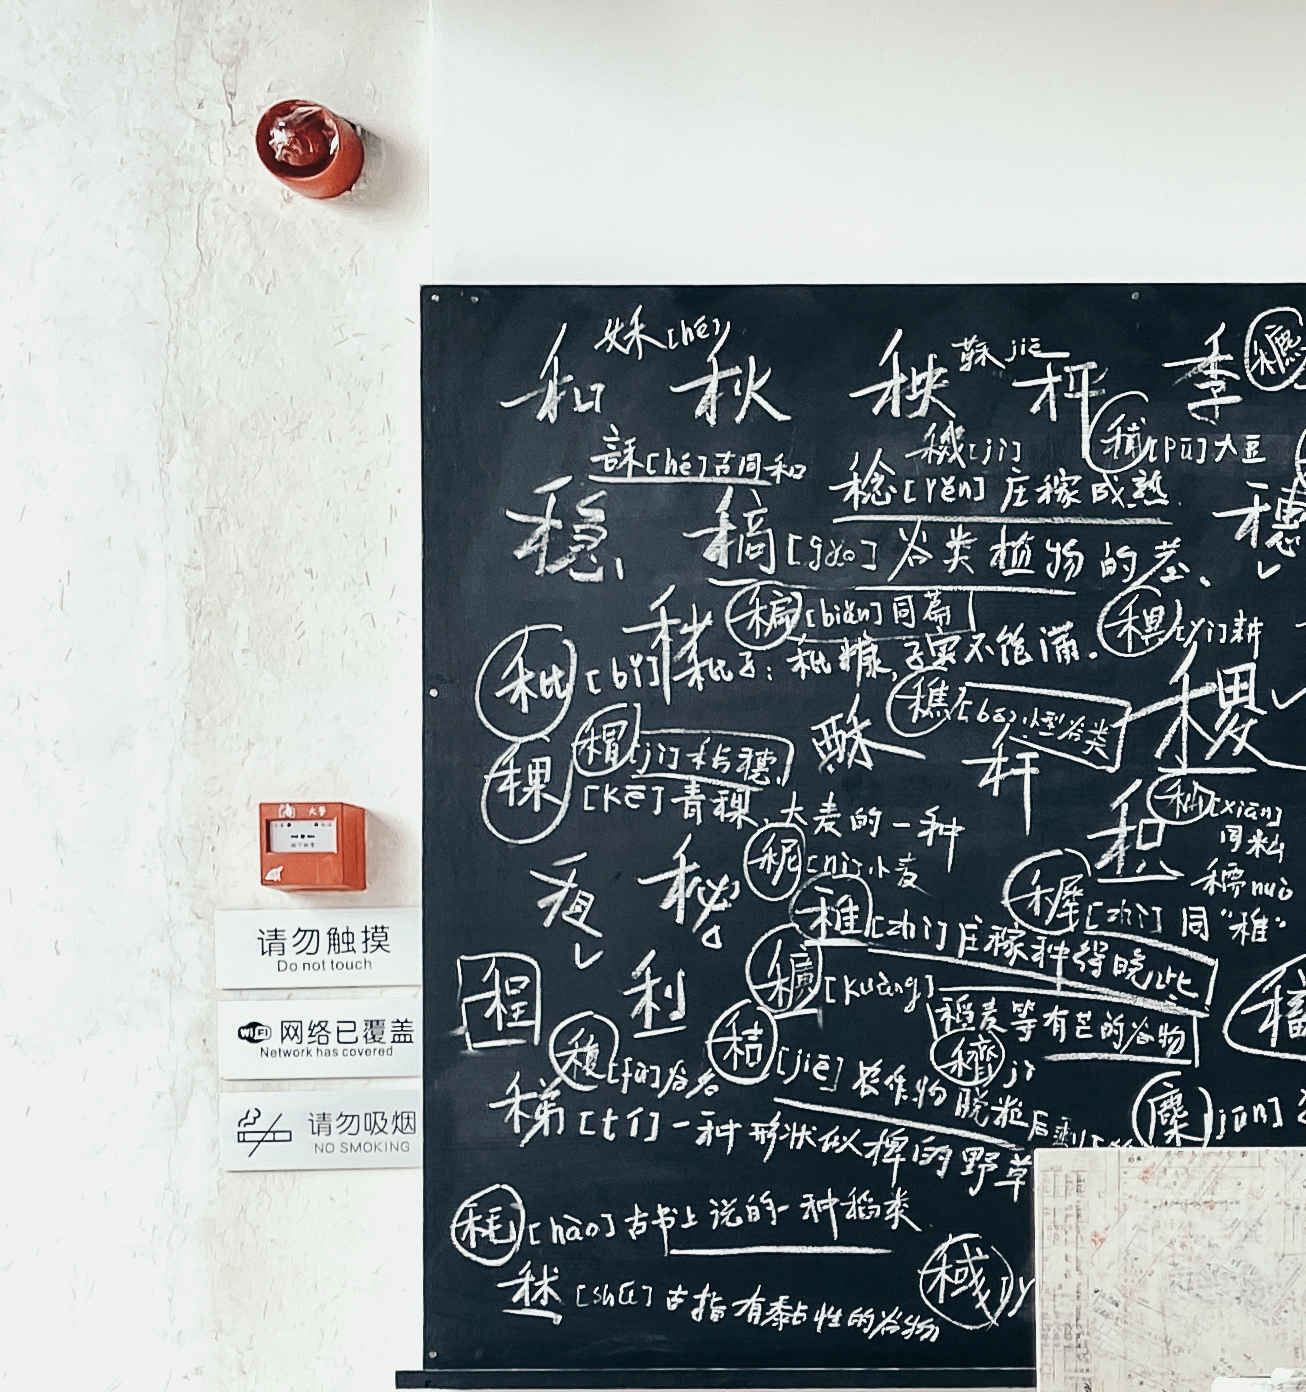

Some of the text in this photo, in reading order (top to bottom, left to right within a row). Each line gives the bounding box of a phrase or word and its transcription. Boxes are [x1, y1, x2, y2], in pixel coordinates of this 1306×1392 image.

[501, 324, 603, 422] 和
[670, 322, 792, 426] 秋
[849, 328, 957, 418] 秧
[1162, 322, 1242, 424] 季
[683, 486, 779, 574] 稿
[257, 926, 391, 957] 请勿触摸
[278, 959, 372, 972] Do not touch
[463, 959, 534, 1032] 程
[622, 949, 686, 1029] 利
[261, 1047, 393, 1058] Network has covered
[281, 1018, 414, 1045] 网络已覆盖
[308, 1111, 416, 1136] 请勿吸烟
[315, 1142, 409, 1154] NO SMOKING
